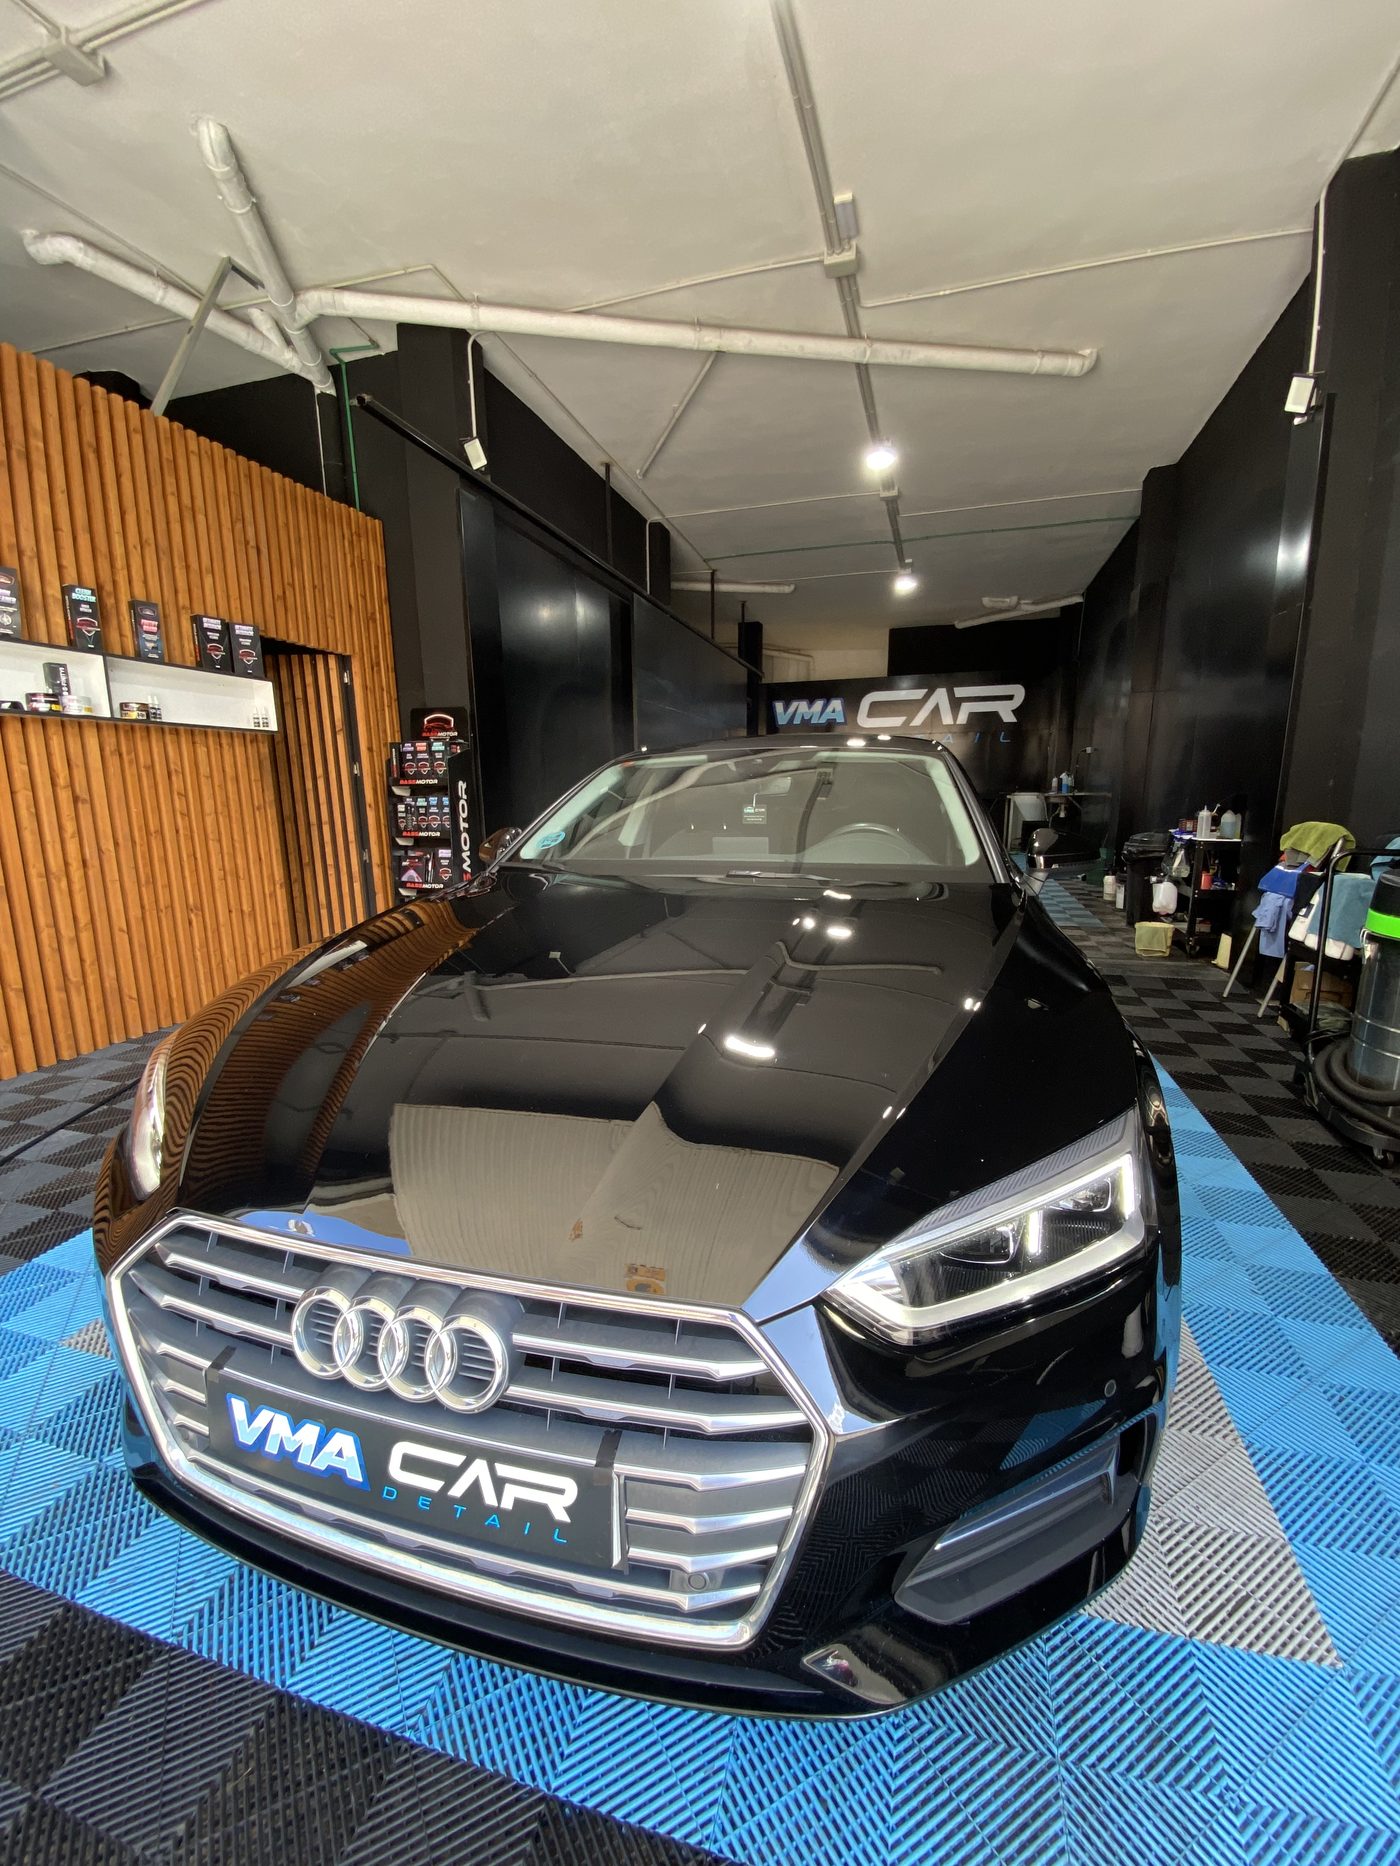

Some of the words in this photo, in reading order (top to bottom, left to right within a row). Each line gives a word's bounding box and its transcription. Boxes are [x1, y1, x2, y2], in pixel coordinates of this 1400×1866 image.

[773, 698, 846, 726] VMA
[856, 684, 1026, 728] CAR
[227, 1395, 366, 1486] VMA
[388, 1440, 579, 1524] CAR
[381, 1485, 569, 1544] DETAIL
